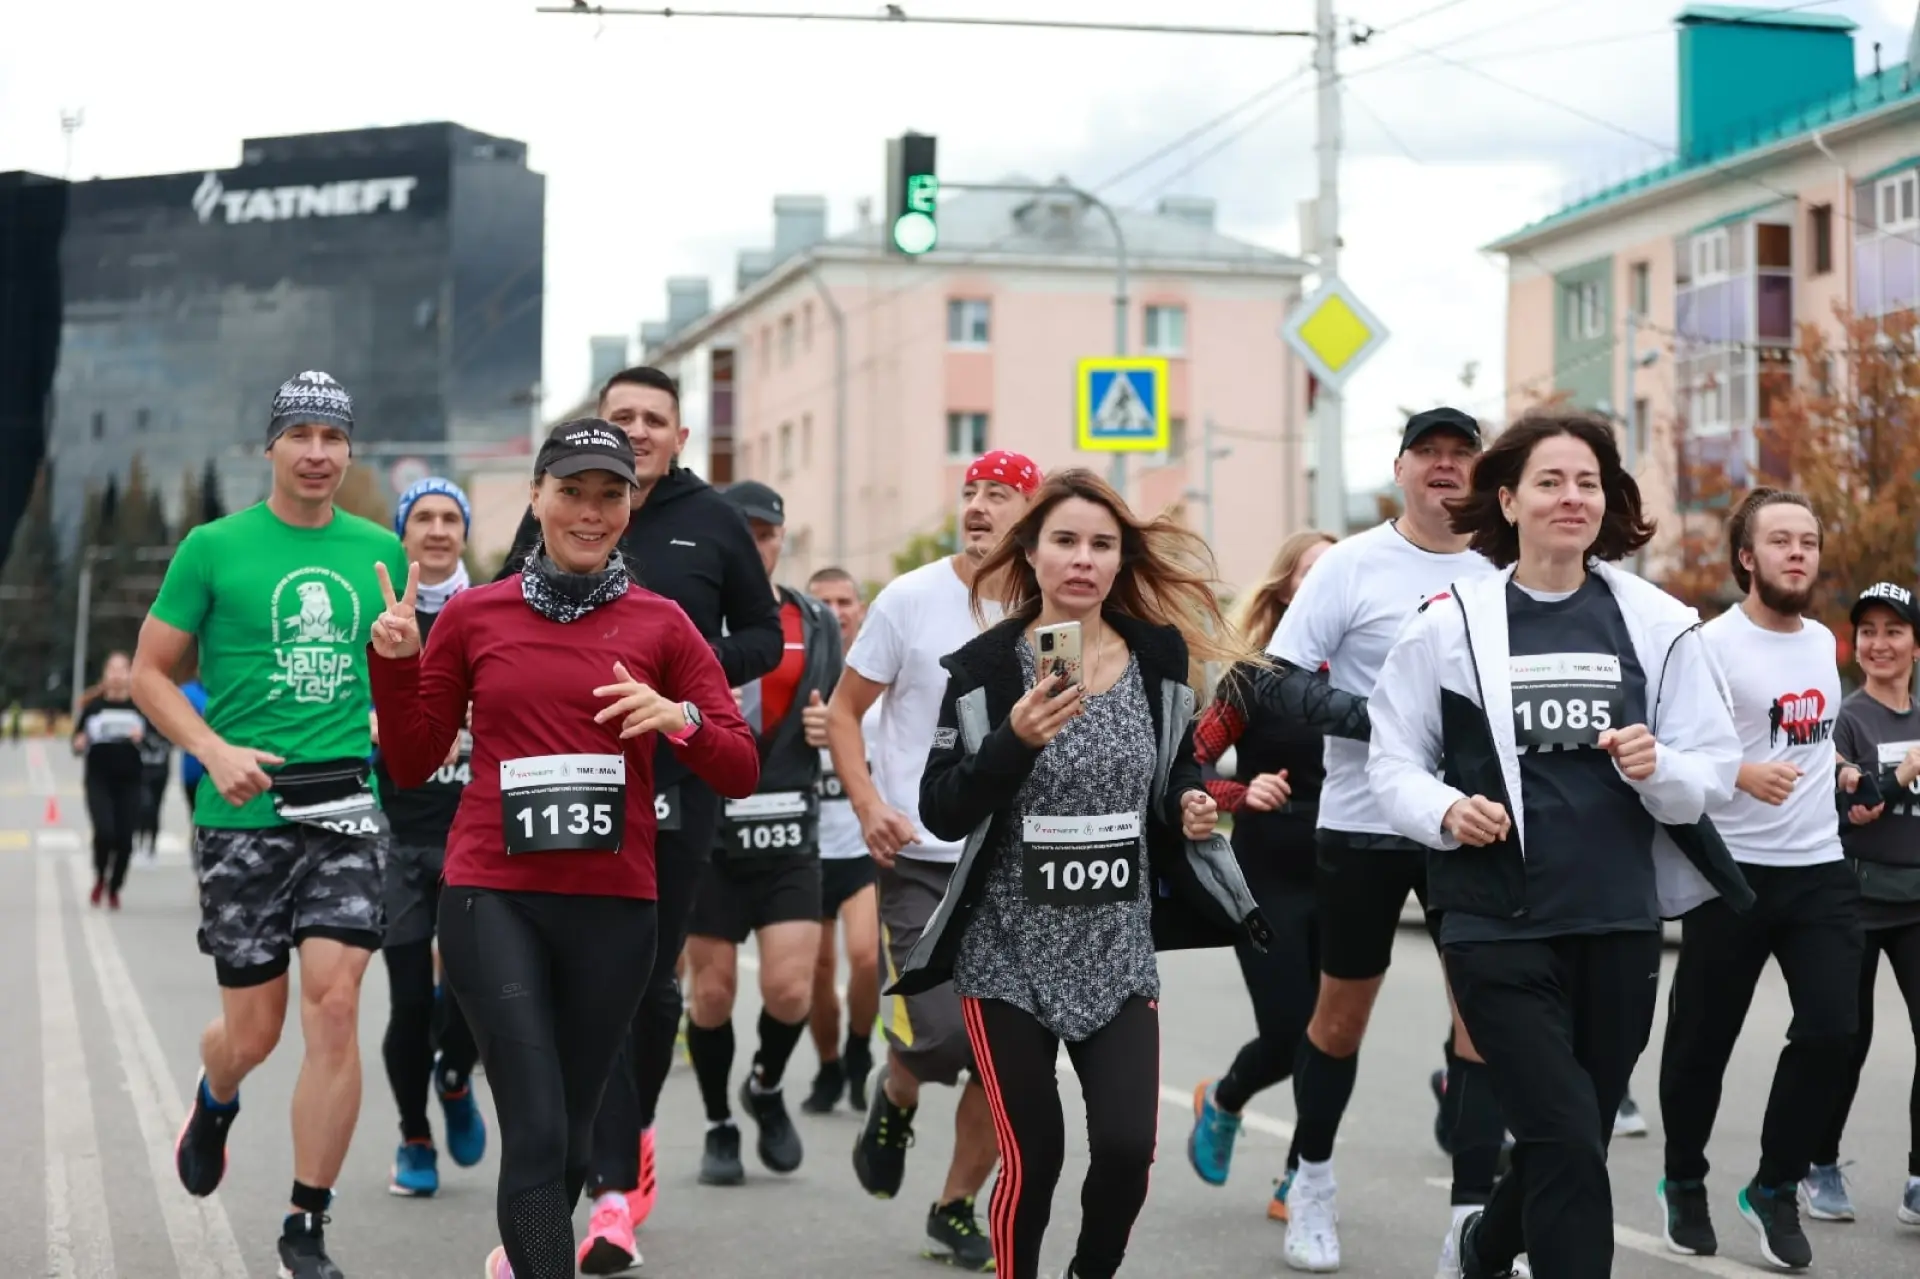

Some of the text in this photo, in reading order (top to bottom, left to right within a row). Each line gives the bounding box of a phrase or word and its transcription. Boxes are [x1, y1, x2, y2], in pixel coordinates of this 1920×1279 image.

[222, 175, 418, 225] TATNEFT
[1514, 698, 1611, 731] 1085
[1782, 696, 1818, 723] RUN
[516, 803, 612, 838] 1135
[654, 794, 671, 820] 6
[737, 823, 802, 849] 1033
[1039, 858, 1129, 891] 1090
